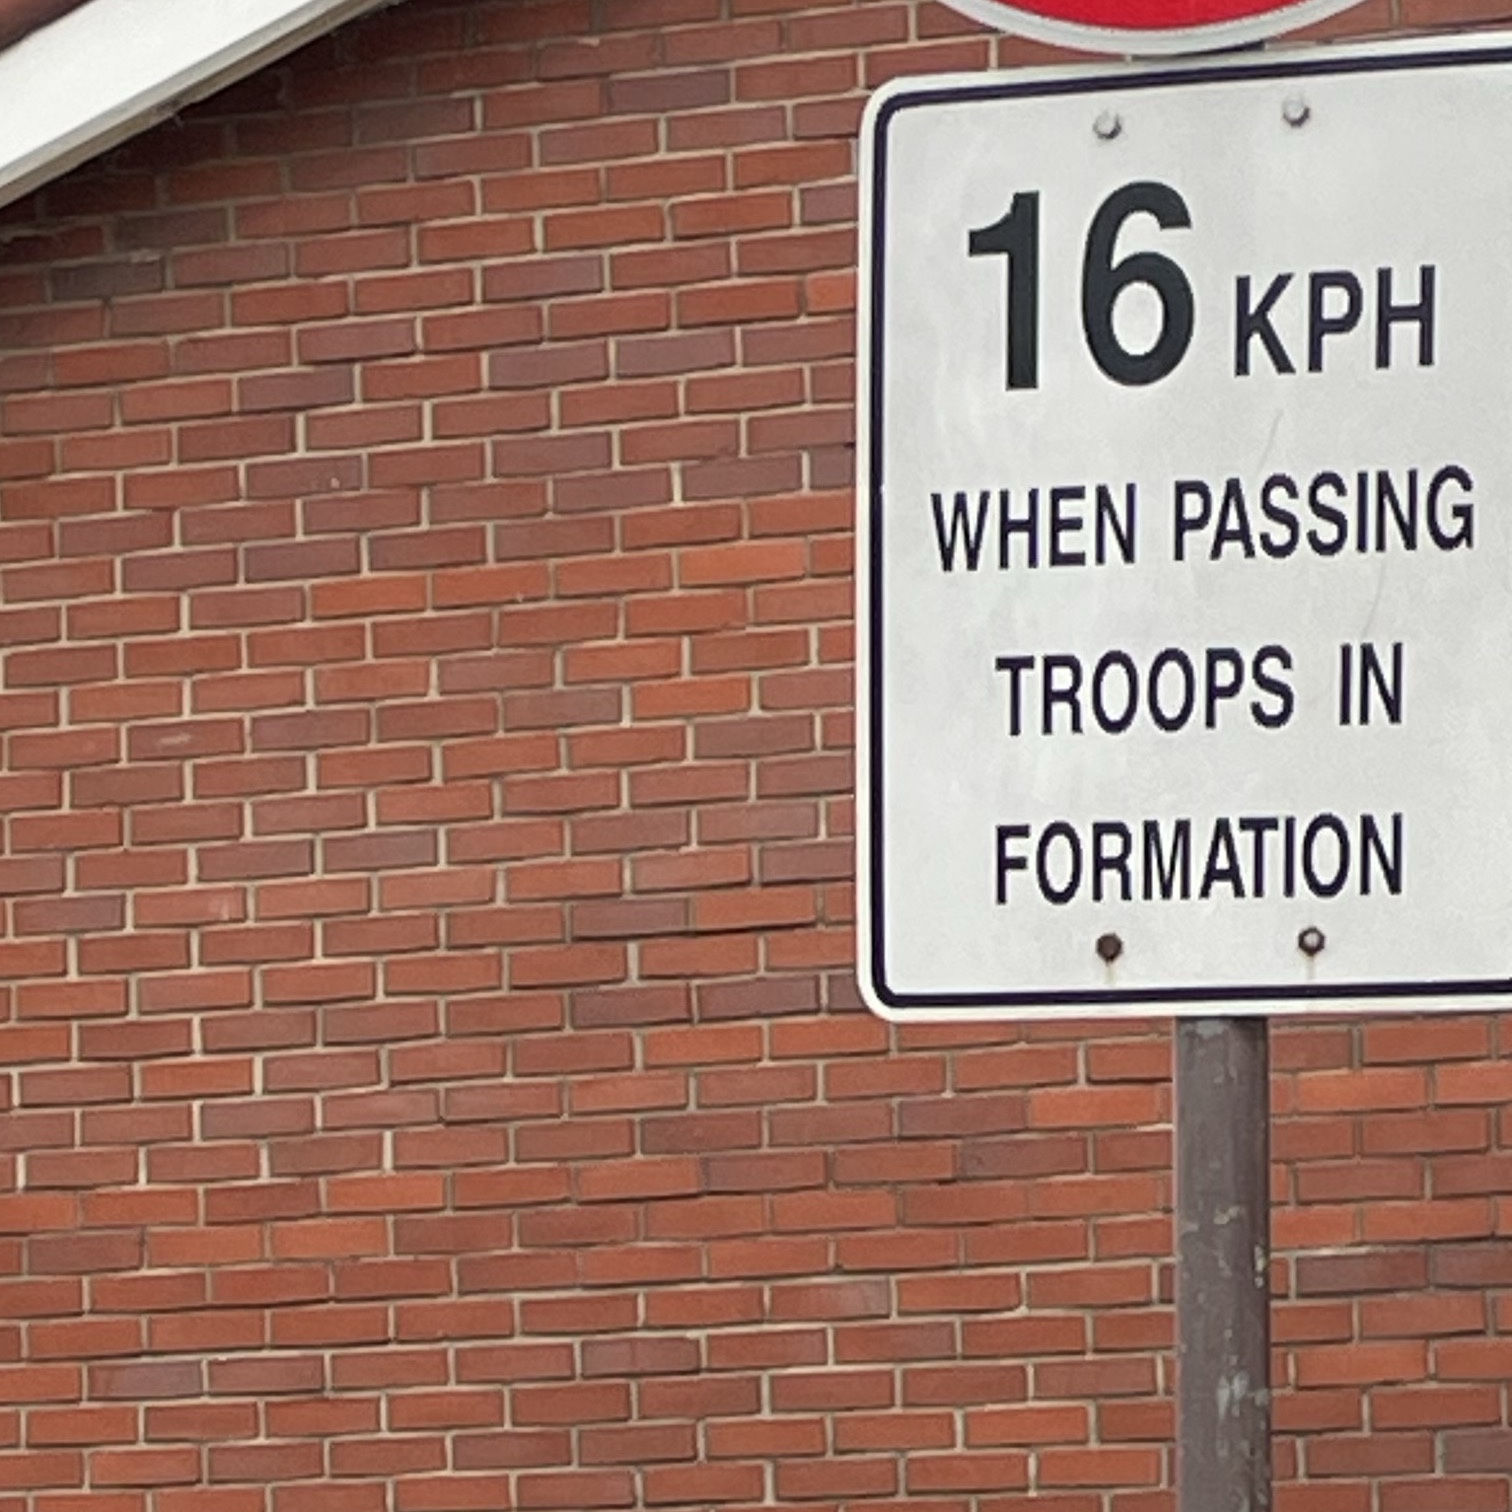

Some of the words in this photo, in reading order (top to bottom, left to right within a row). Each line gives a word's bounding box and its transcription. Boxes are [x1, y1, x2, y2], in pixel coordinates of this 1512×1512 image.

[969, 181, 1195, 391] 16
[1235, 265, 1436, 377] KPH
[931, 483, 1136, 572] WHEN
[1175, 465, 1474, 562] PASSING
[995, 645, 1294, 737] TROOPS
[1340, 642, 1403, 726] IN
[996, 812, 1402, 905] FORMATION
